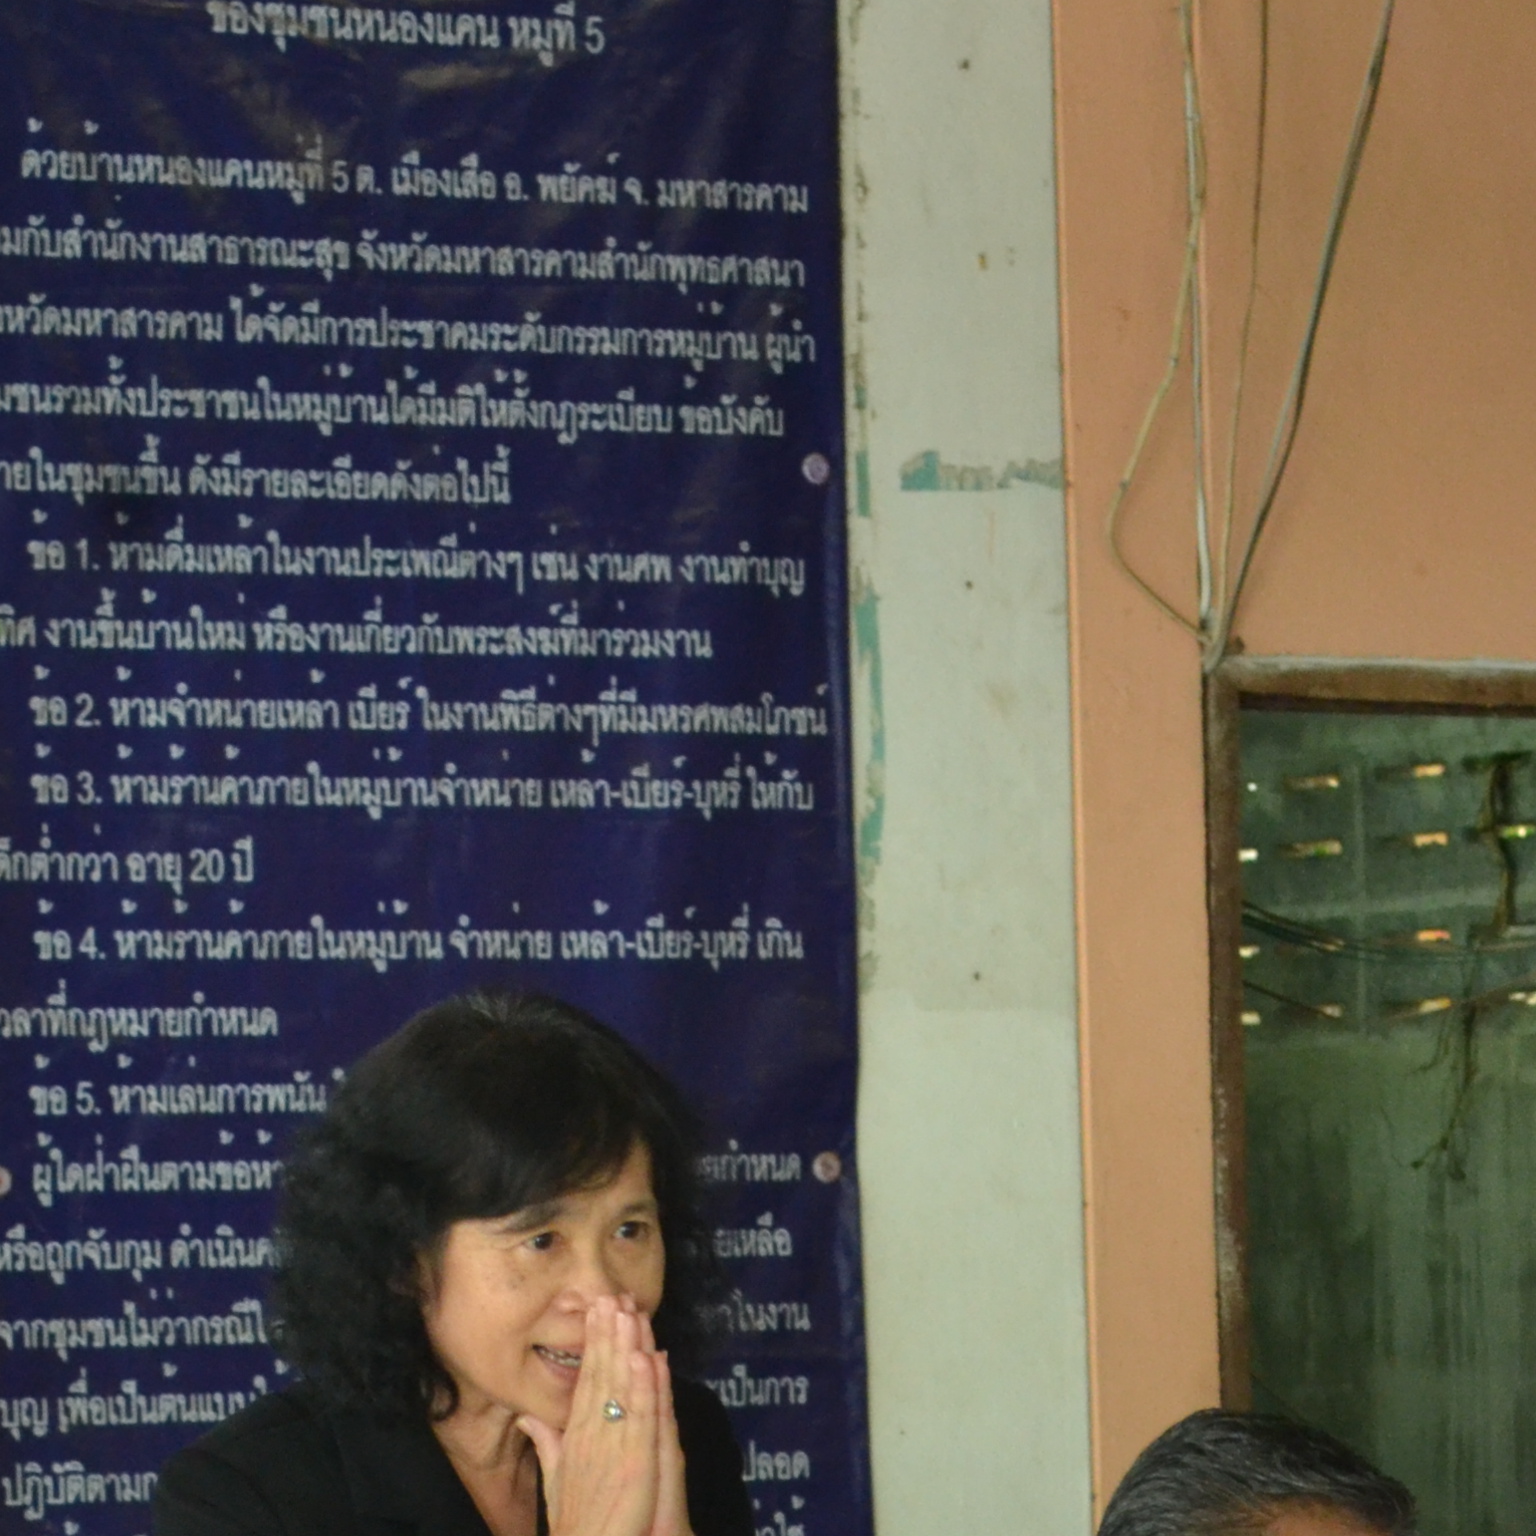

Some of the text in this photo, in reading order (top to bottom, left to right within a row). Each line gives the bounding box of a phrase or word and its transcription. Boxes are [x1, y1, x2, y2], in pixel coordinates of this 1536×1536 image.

[585, 15, 605, 54] 5
[331, 161, 350, 194] 5
[657, 177, 808, 214] มหาสารคาม
[75, 539, 100, 571] 1.
[75, 692, 101, 727] 2.
[76, 770, 102, 805] 3.
[126, 851, 183, 895] อายุ
[190, 848, 224, 882] 20
[230, 835, 255, 882] ปี
[78, 926, 106, 961] 4.
[75, 1081, 102, 1116] 5.
